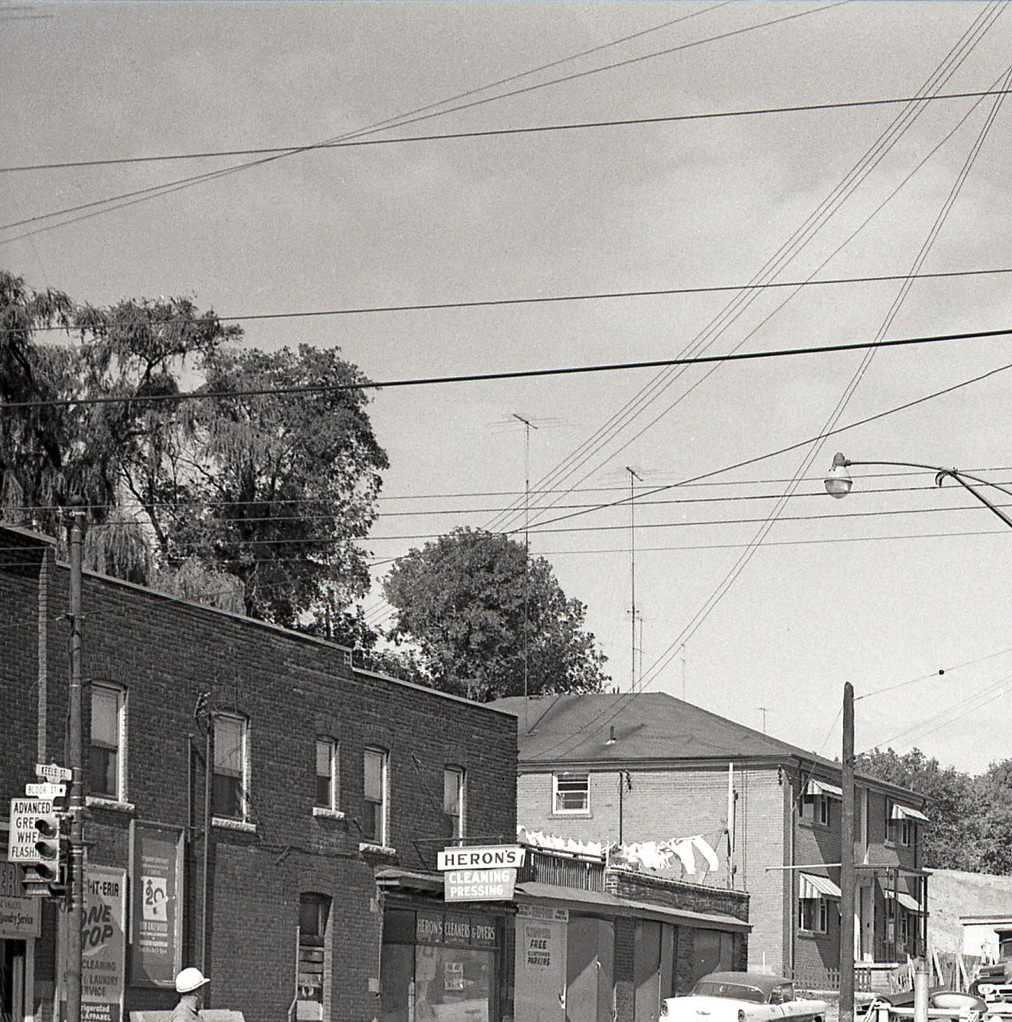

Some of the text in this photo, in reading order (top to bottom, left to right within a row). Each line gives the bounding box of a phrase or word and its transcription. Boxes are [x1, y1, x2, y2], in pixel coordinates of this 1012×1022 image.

[14, 802, 50, 814] ADVANCED
[17, 831, 40, 843] WHE
[445, 849, 516, 867] HERON'S
[449, 869, 510, 885] CLEANING
[450, 884, 504, 897] PRESSING
[81, 924, 113, 949] TOP
[444, 921, 470, 938] CLEANERS
[477, 924, 496, 940] DYERS
[530, 939, 547, 949] FREE
[528, 956, 550, 966] PARKING
[81, 985, 105, 997] ERVICE
